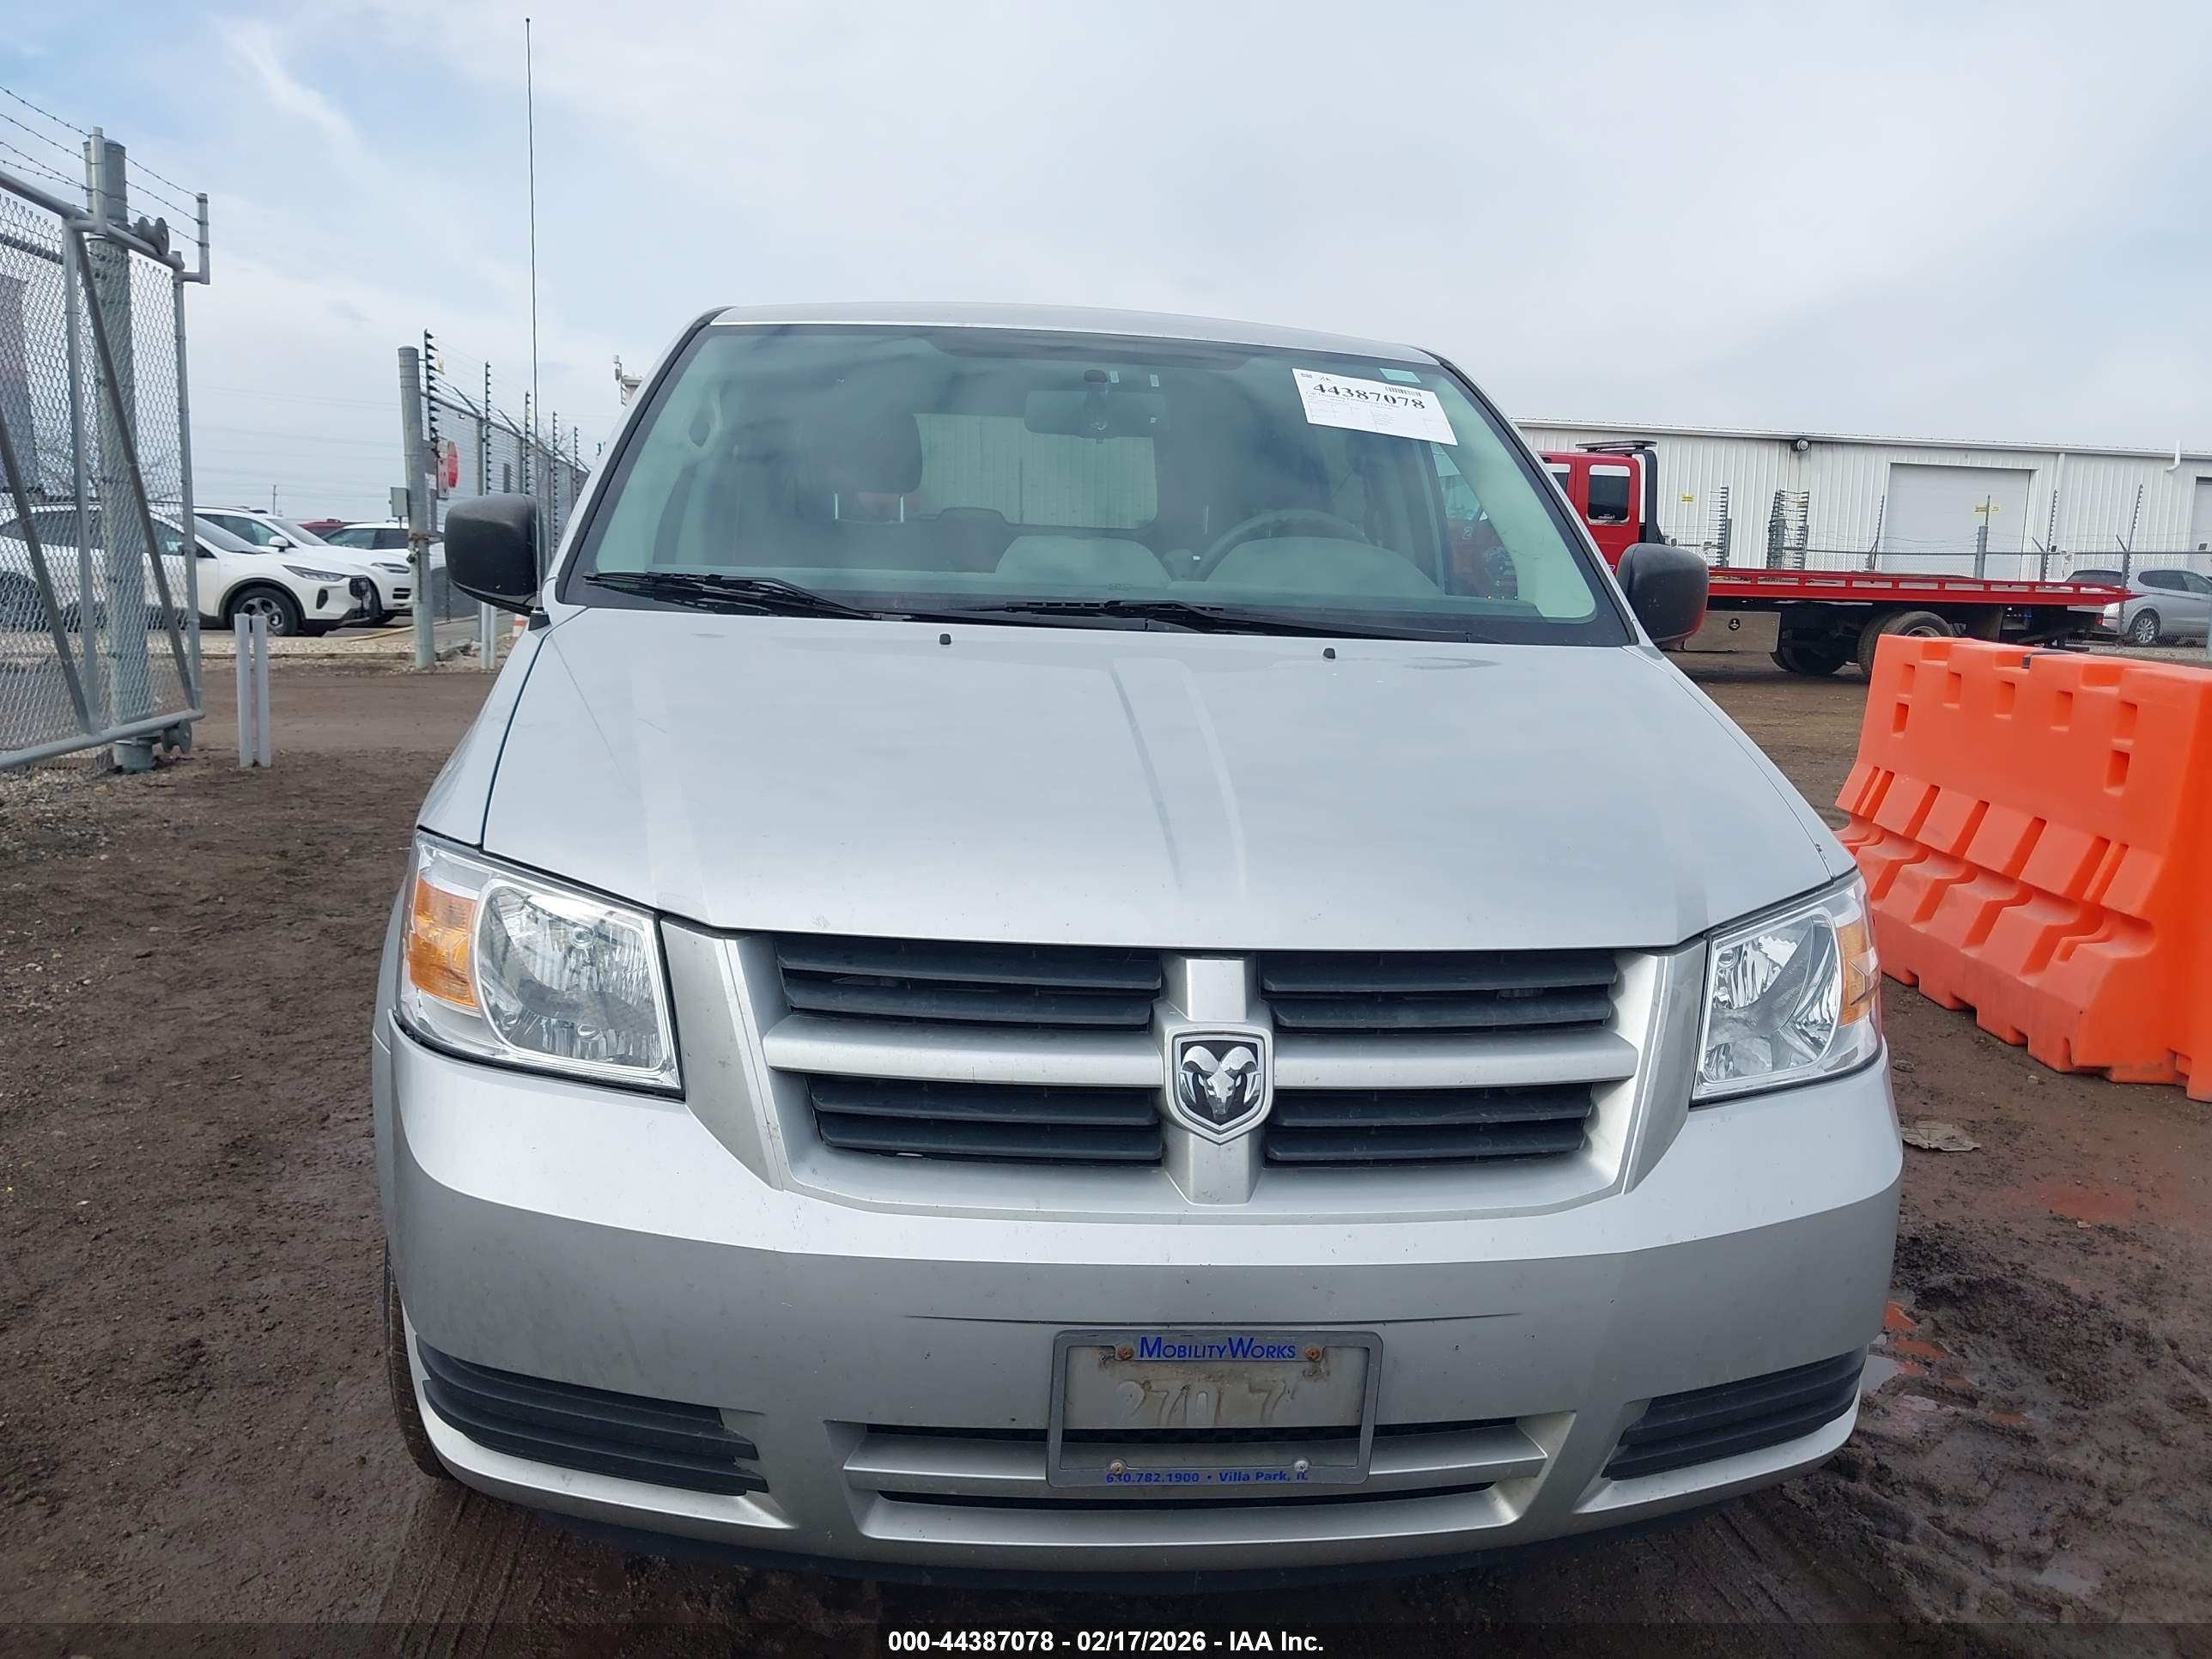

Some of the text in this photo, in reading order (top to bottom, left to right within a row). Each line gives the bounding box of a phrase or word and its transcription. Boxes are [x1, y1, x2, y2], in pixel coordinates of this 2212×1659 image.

[1313, 383, 1425, 410] 44387078
[1218, 1471, 1250, 1482] Villa
[1255, 1470, 1291, 1481] Park,
